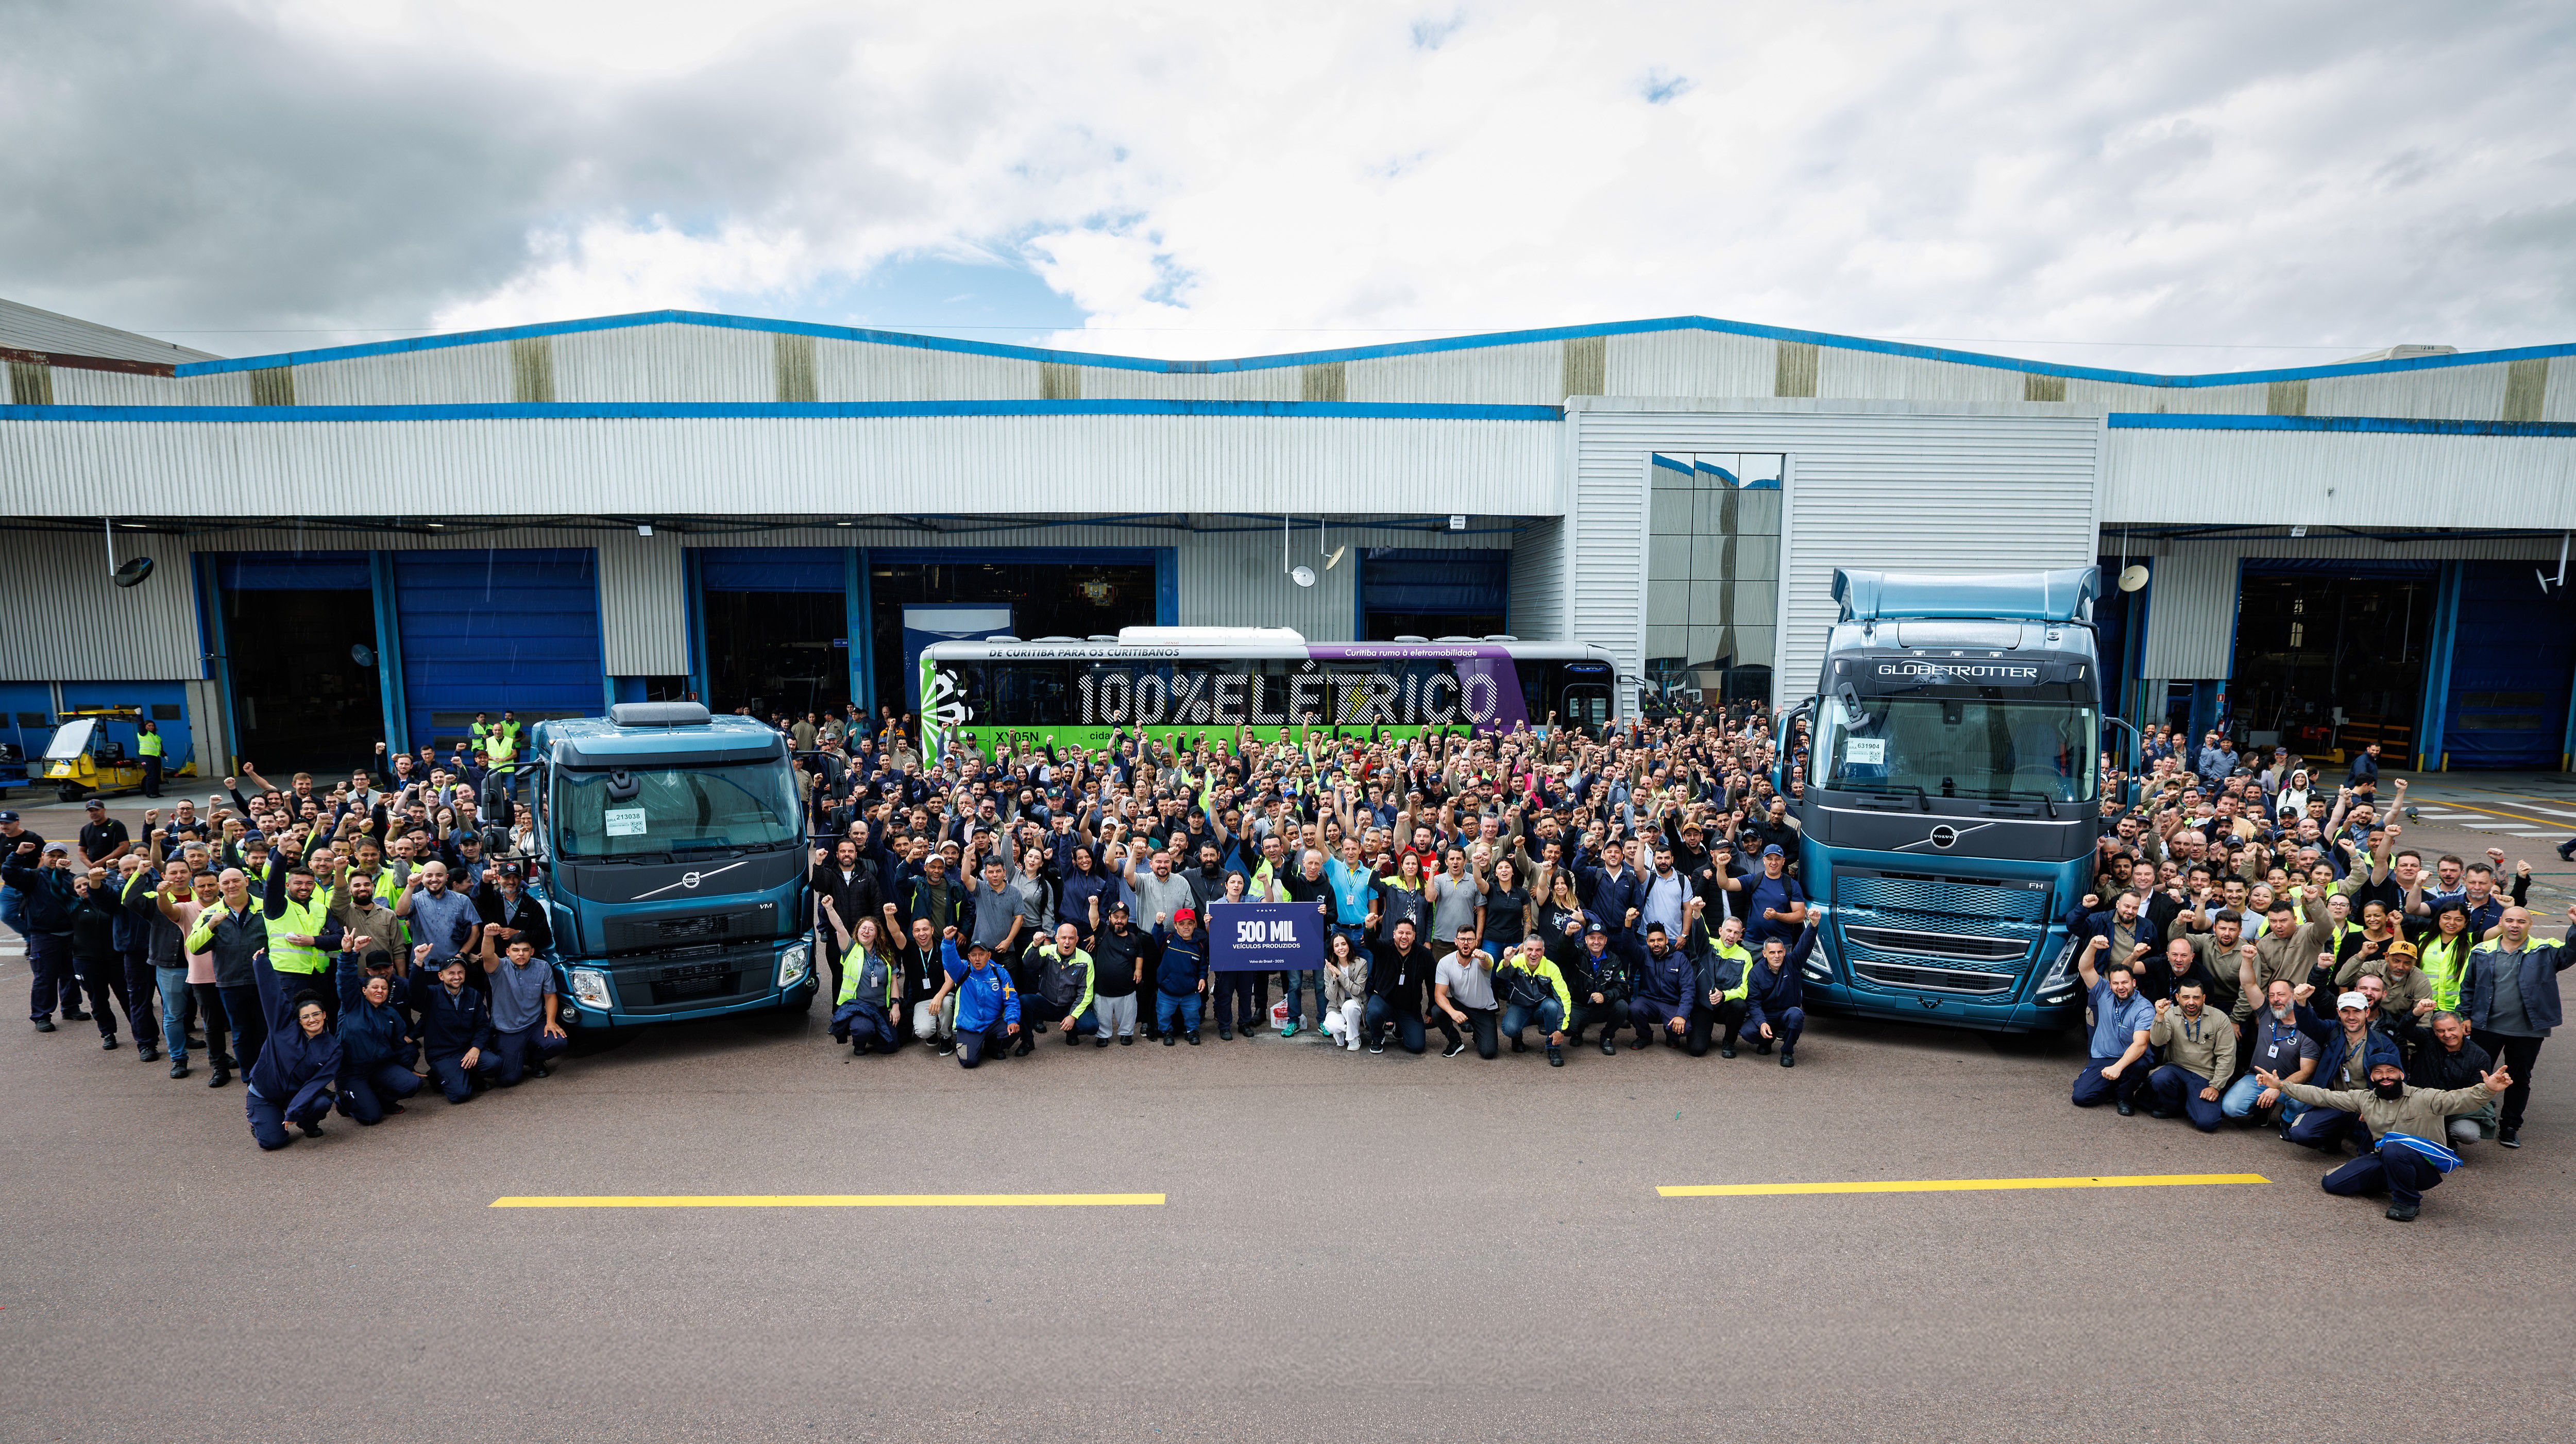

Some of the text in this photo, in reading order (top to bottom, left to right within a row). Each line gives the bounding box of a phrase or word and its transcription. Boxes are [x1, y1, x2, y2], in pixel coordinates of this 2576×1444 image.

[1107, 649, 1179, 657] CURITIBANOS
[1345, 649, 1377, 657] Curitiba
[1402, 649, 1408, 657] à
[1410, 649, 1478, 657] eletromobilidade
[1878, 665, 2038, 678] GLOBETROTTER
[1090, 732, 1114, 740] cida
[1237, 920, 1297, 942] 500 MIL
